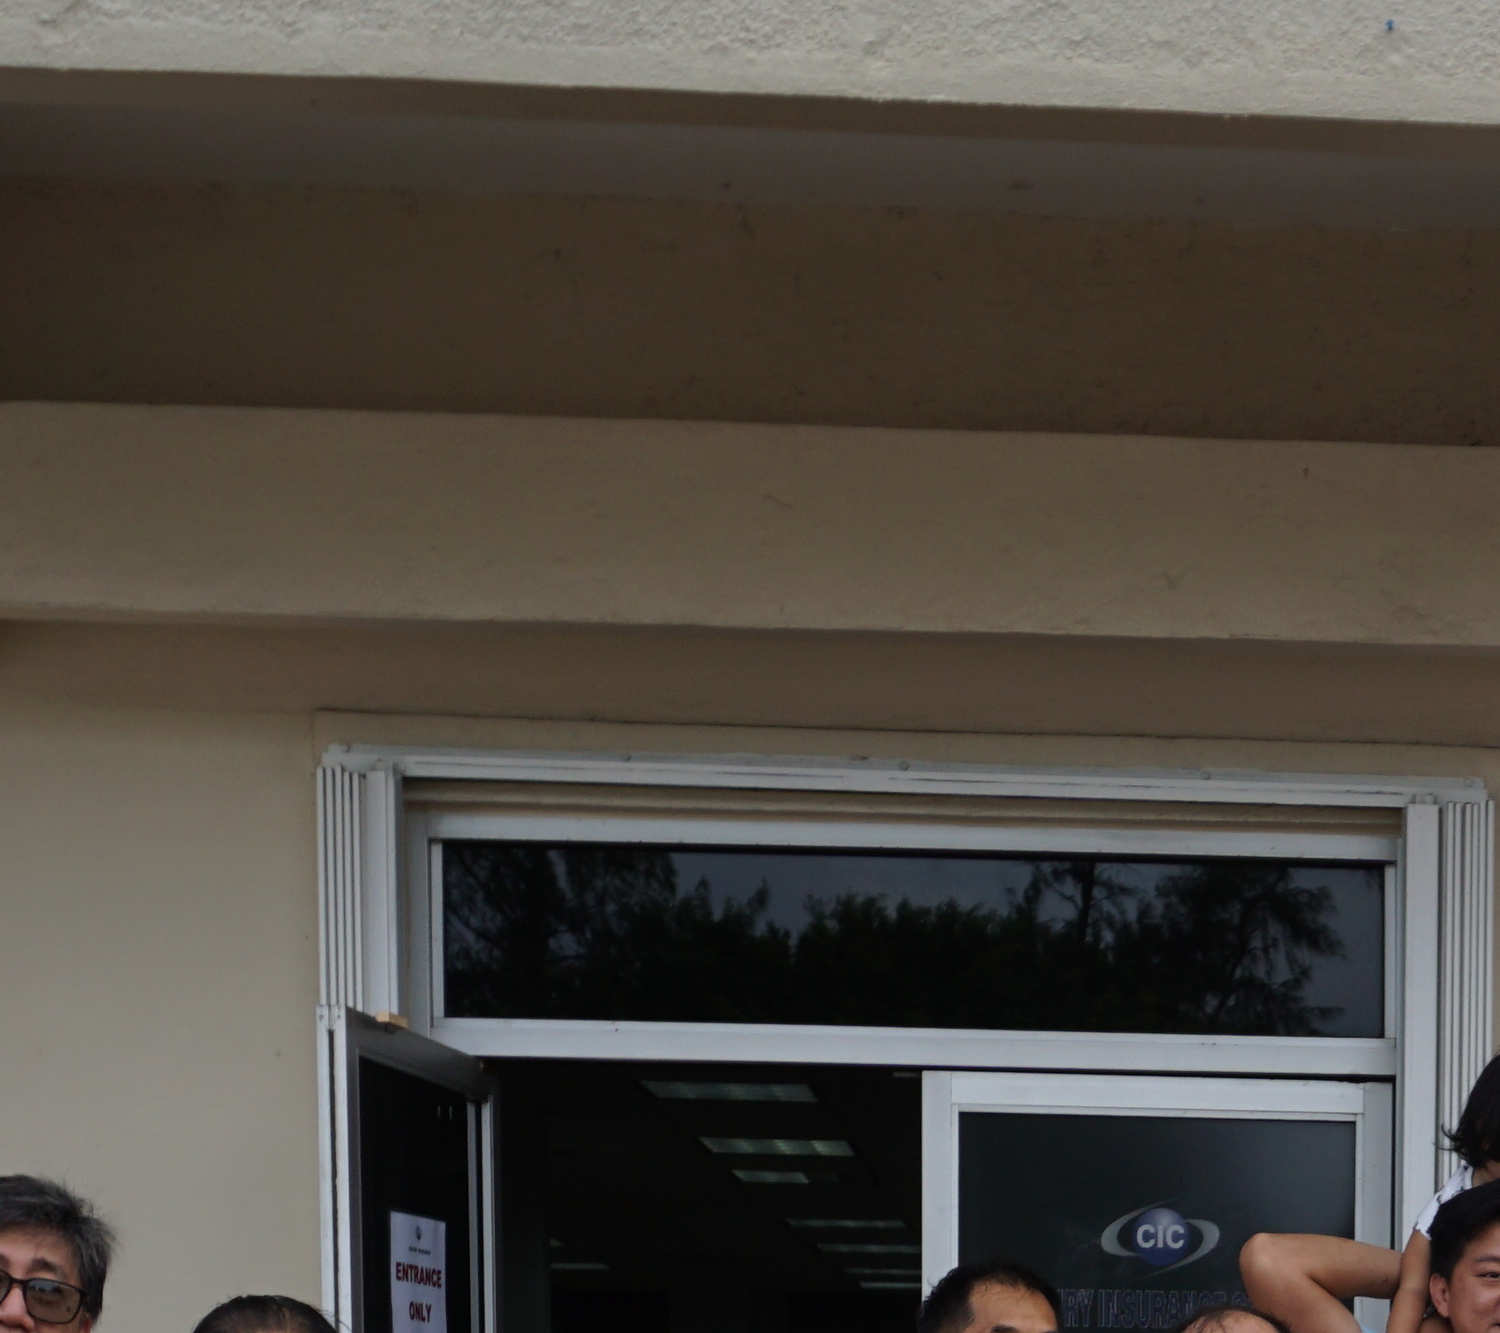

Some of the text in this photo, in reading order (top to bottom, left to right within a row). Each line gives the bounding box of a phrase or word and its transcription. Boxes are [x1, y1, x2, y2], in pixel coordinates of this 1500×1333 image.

[1136, 1223, 1186, 1249] CIC
[395, 1261, 442, 1289] ENTRANCE
[409, 1301, 432, 1323] ONLY
